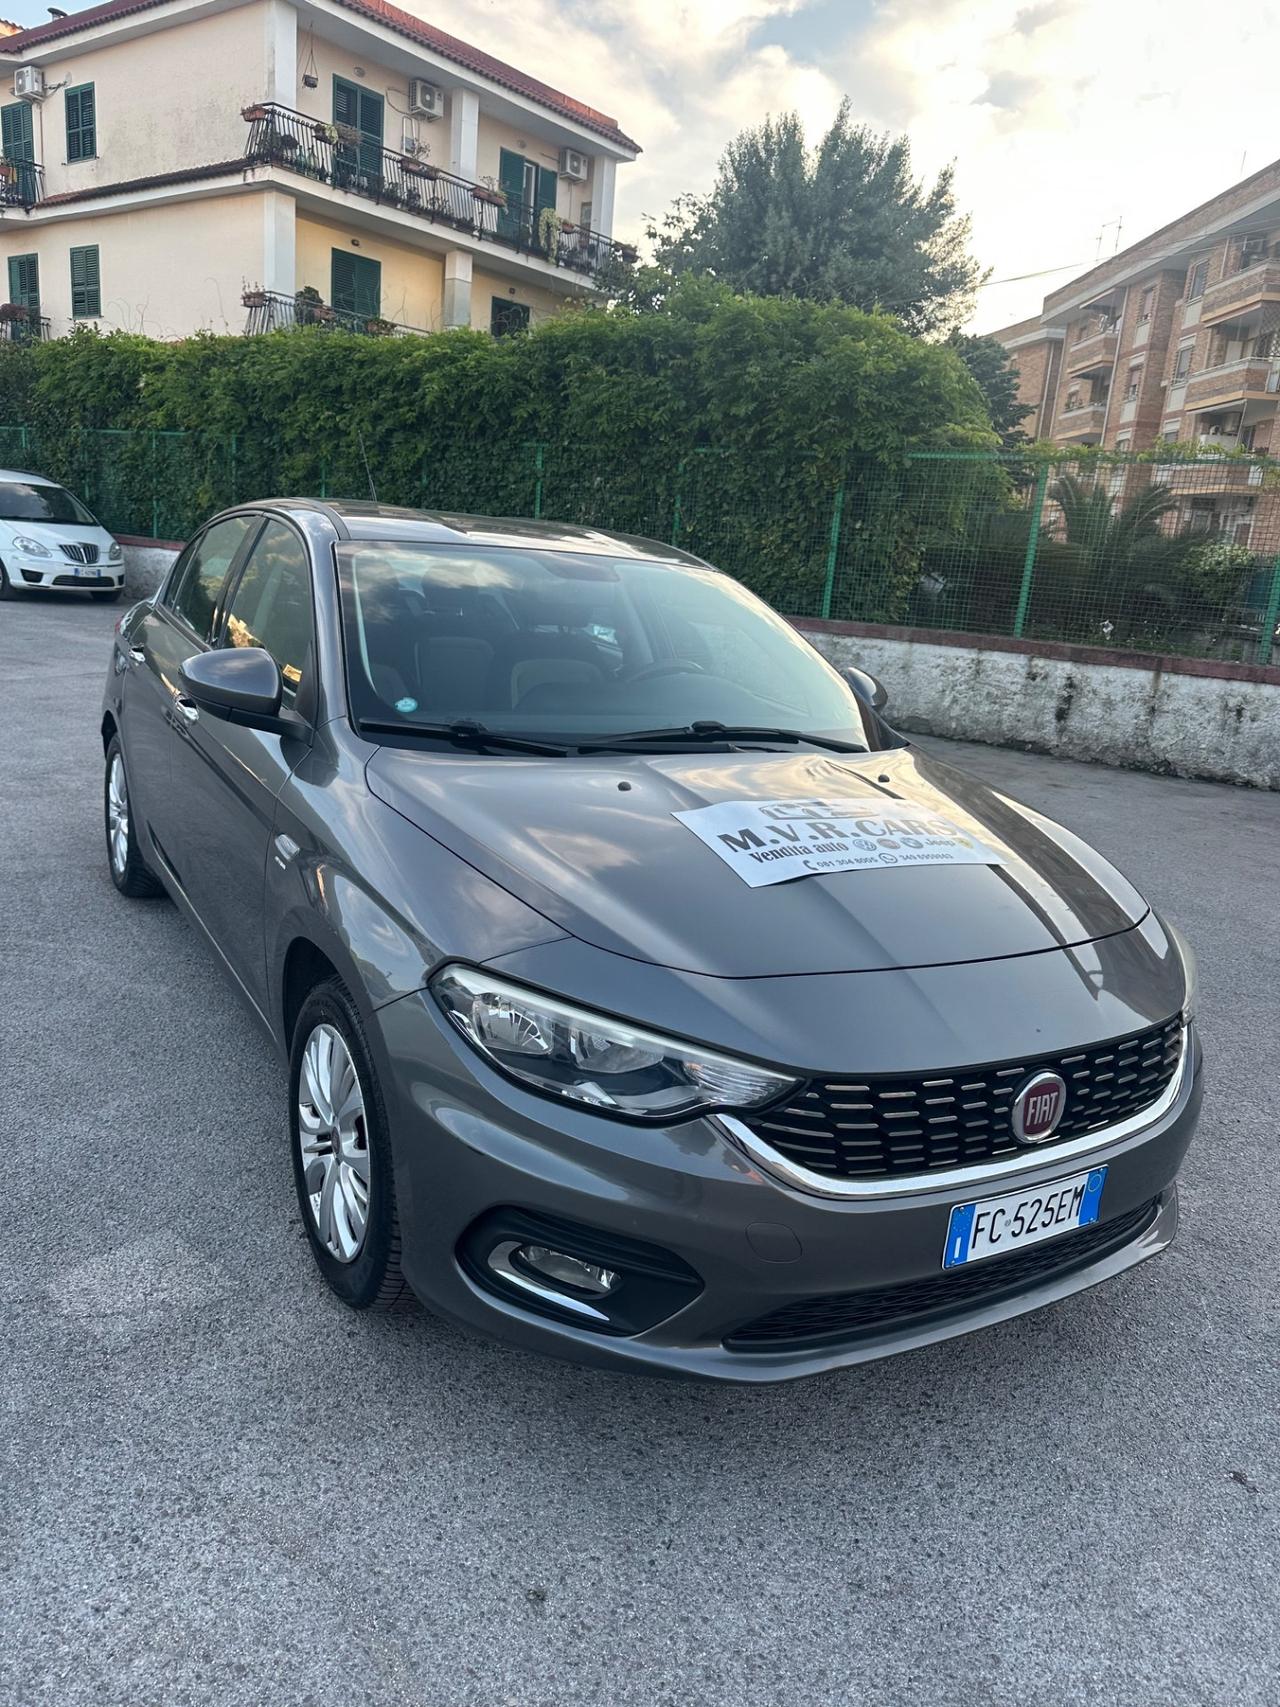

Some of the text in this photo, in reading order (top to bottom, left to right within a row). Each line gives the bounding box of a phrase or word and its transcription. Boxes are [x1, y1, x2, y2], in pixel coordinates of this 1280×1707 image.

[814, 841, 849, 853] auto
[1026, 1092, 1059, 1127] FIAT
[972, 1184, 1086, 1249] FC 525EM
